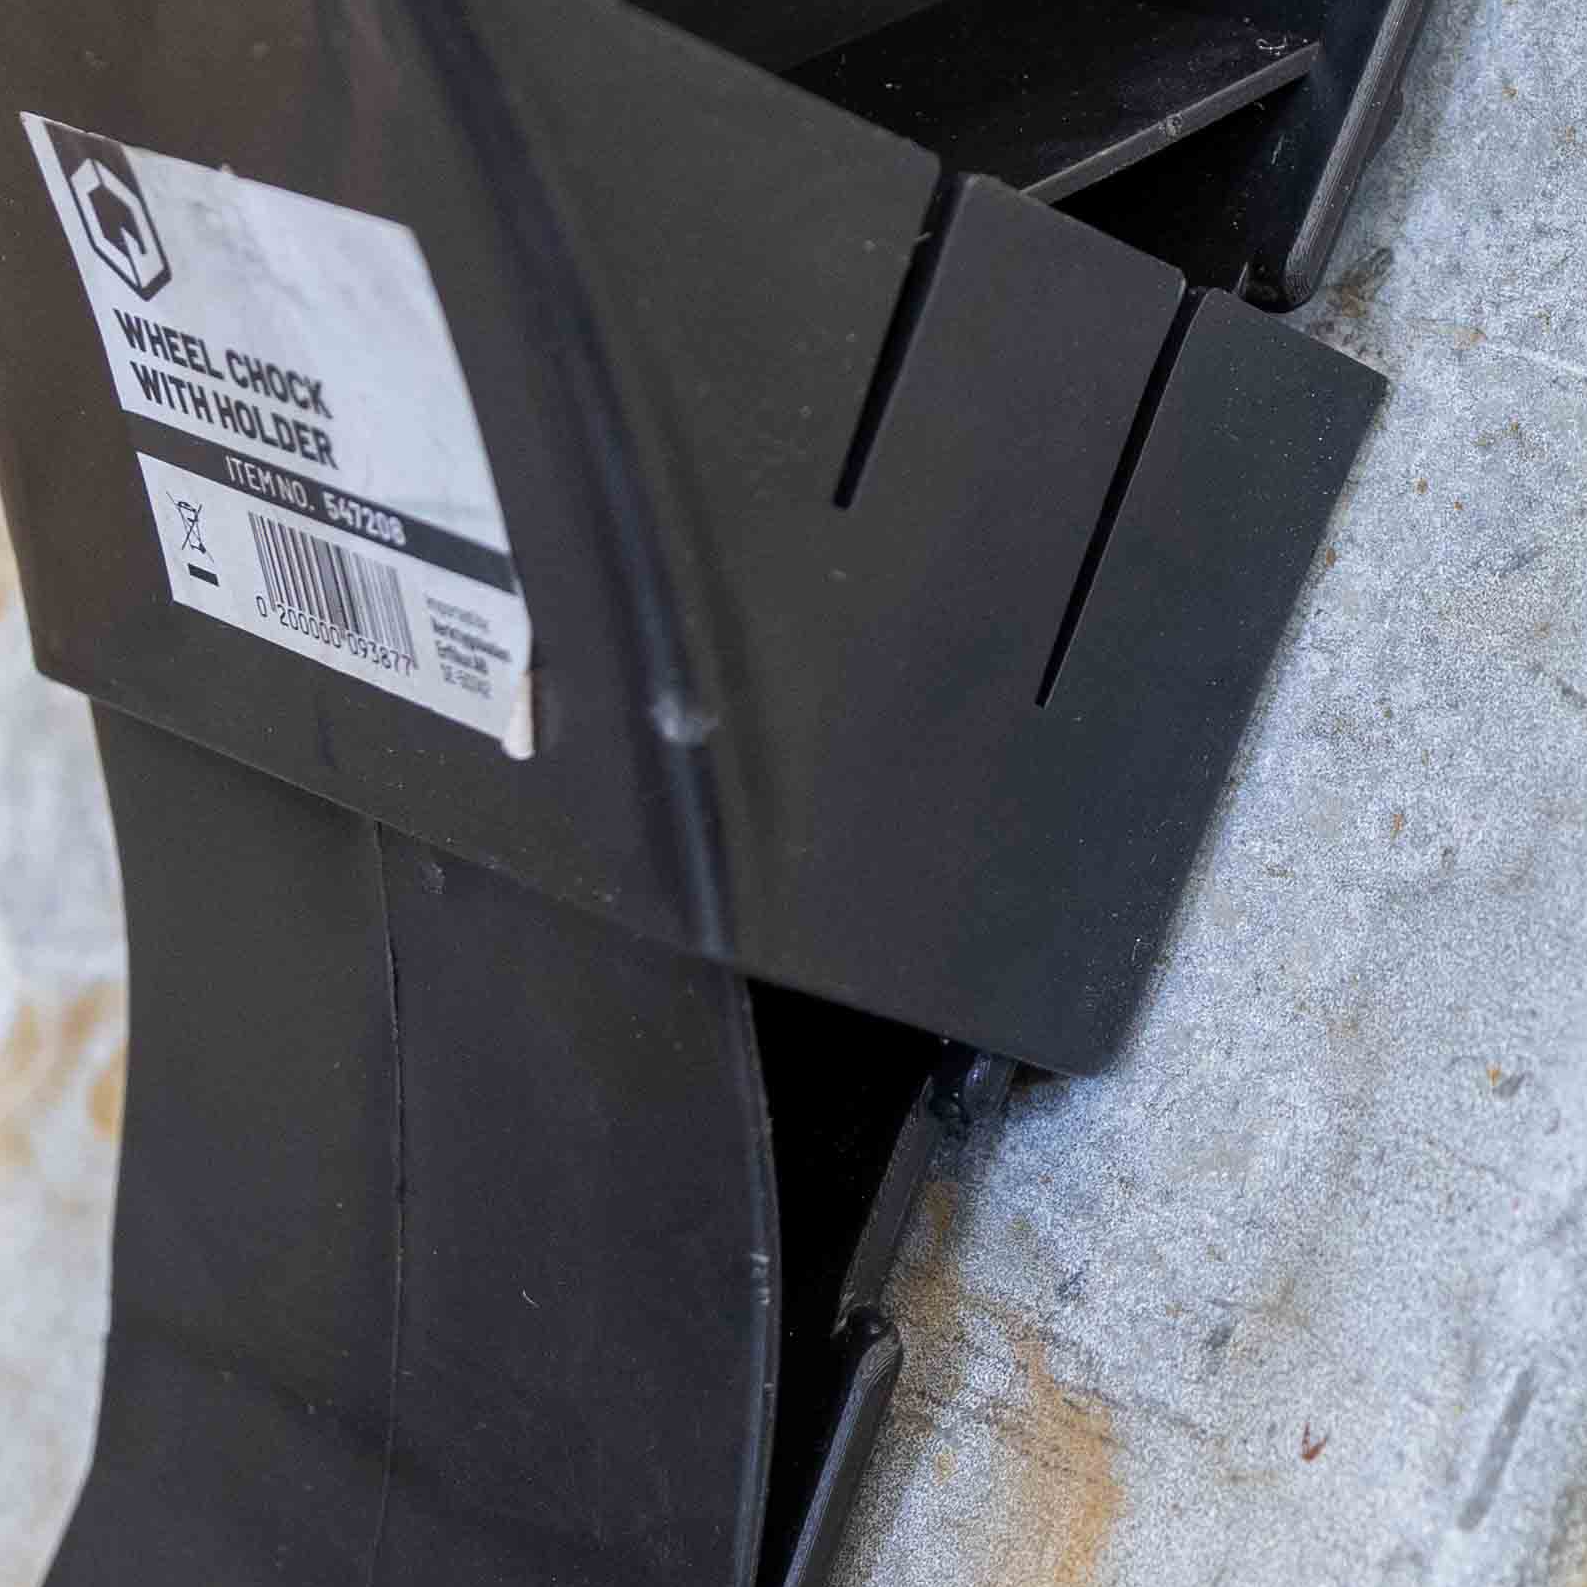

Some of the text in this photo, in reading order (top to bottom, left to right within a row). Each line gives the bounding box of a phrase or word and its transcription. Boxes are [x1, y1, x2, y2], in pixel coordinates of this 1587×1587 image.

[113, 307, 333, 419] WHEEL CHOCK
[130, 360, 339, 470] WITH HOLDER
[224, 455, 277, 498] ITEM
[273, 475, 316, 512] NO.
[255, 595, 269, 618] 0
[277, 603, 342, 649] 200000
[347, 631, 412, 677] 093877
